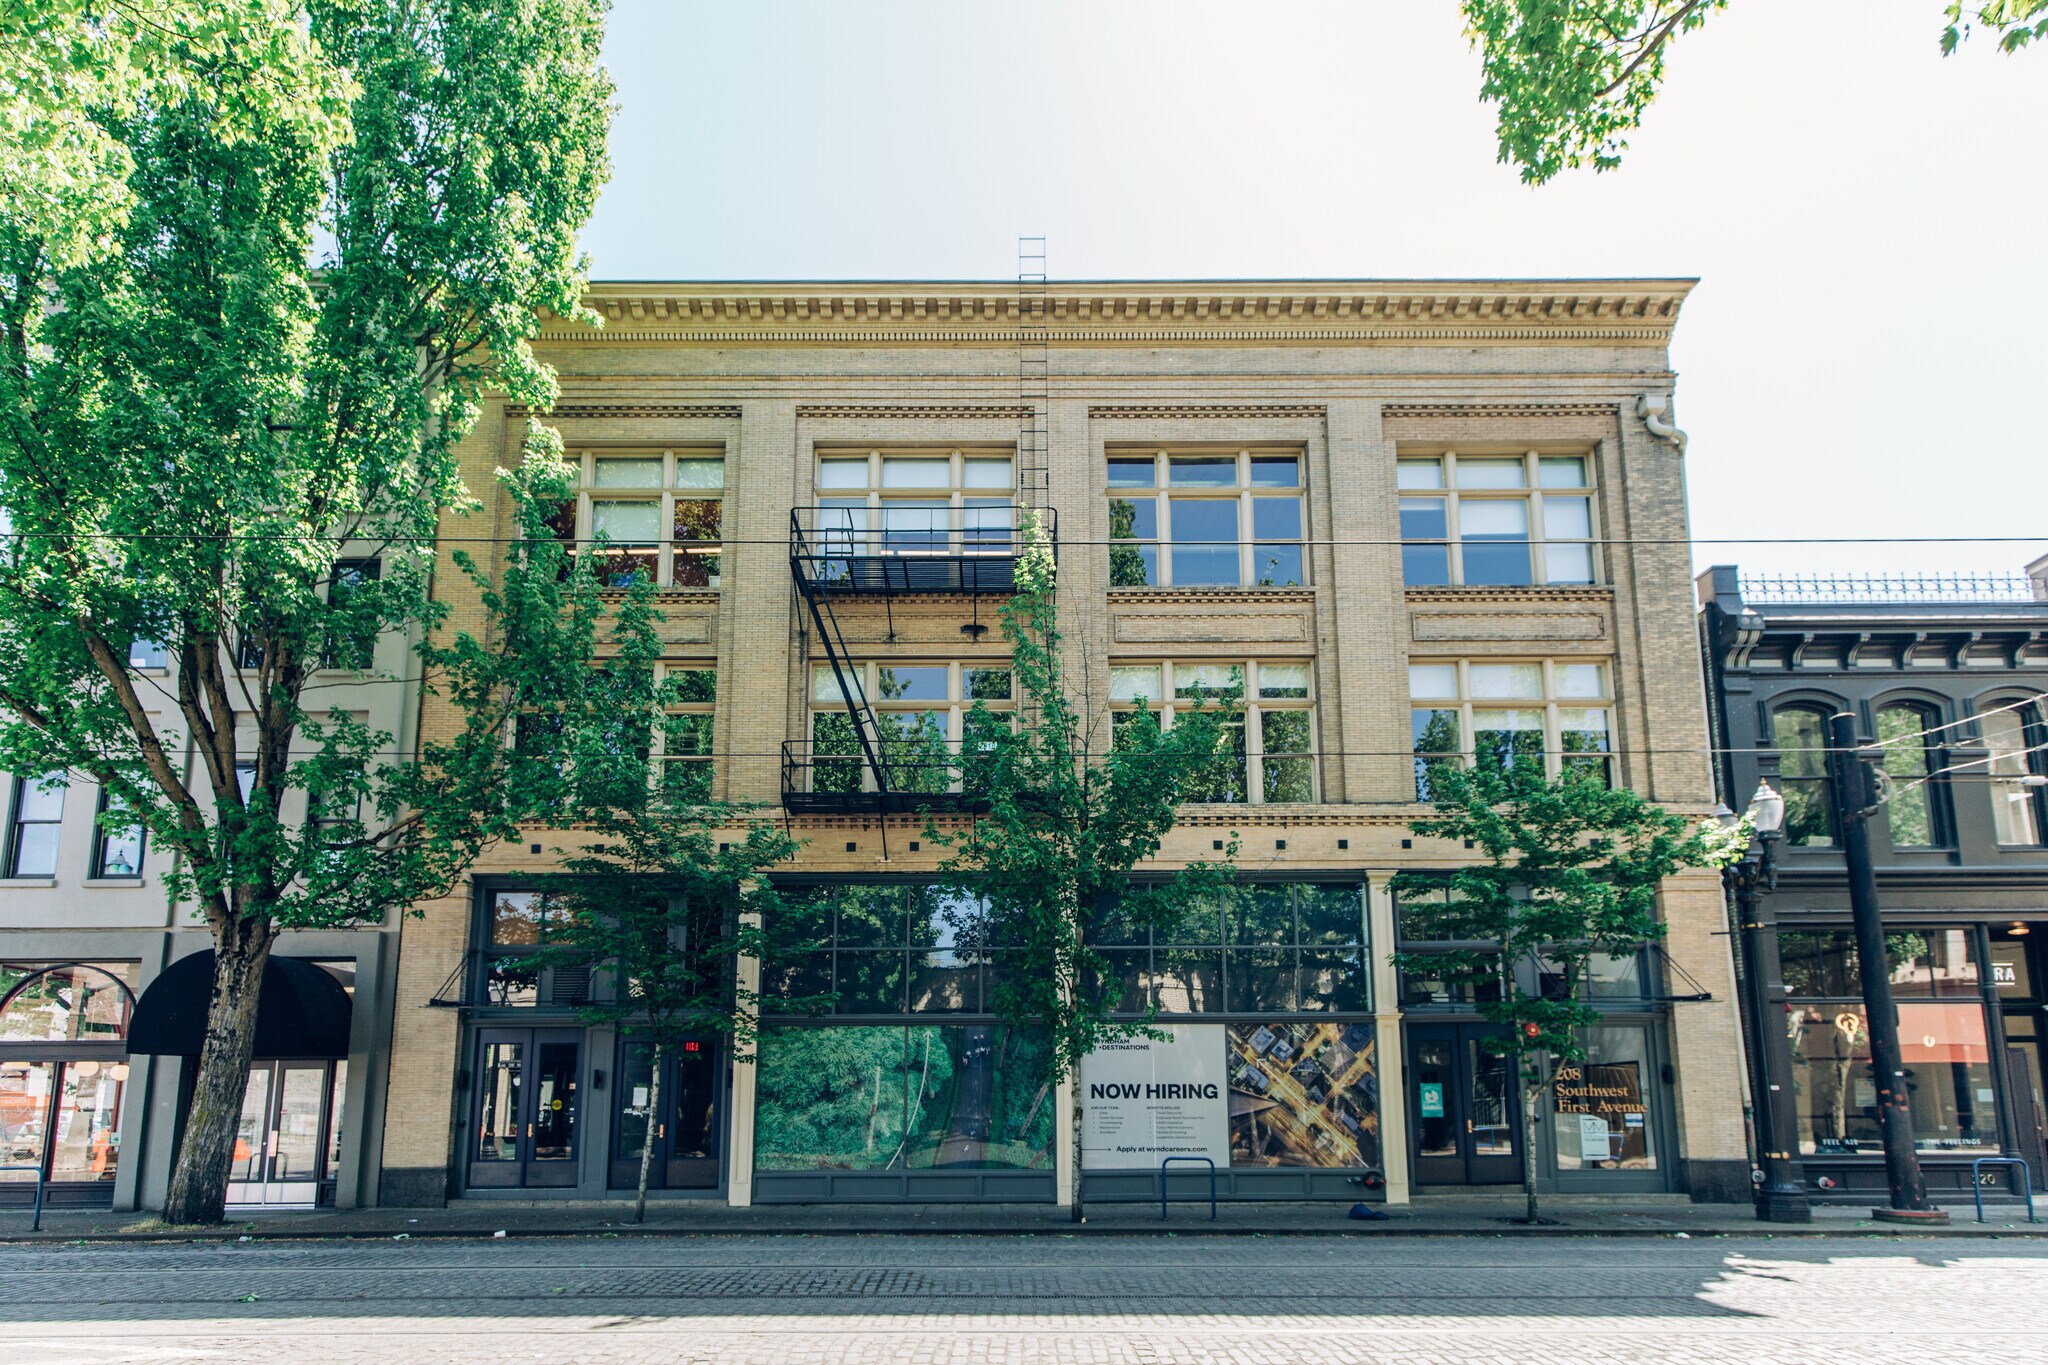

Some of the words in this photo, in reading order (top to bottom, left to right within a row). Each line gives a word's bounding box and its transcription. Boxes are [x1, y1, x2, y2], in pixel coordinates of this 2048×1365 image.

[1091, 1083, 1141, 1099] NOW
[1146, 1083, 1219, 1099] HIRING
[1556, 1083, 1629, 1097] Southwest
[1558, 1099, 1591, 1113] First
[1597, 1100, 1648, 1113] Avenue
[1116, 1145, 1136, 1153] Apply
[1146, 1145, 1208, 1153] wyndcareers.com
